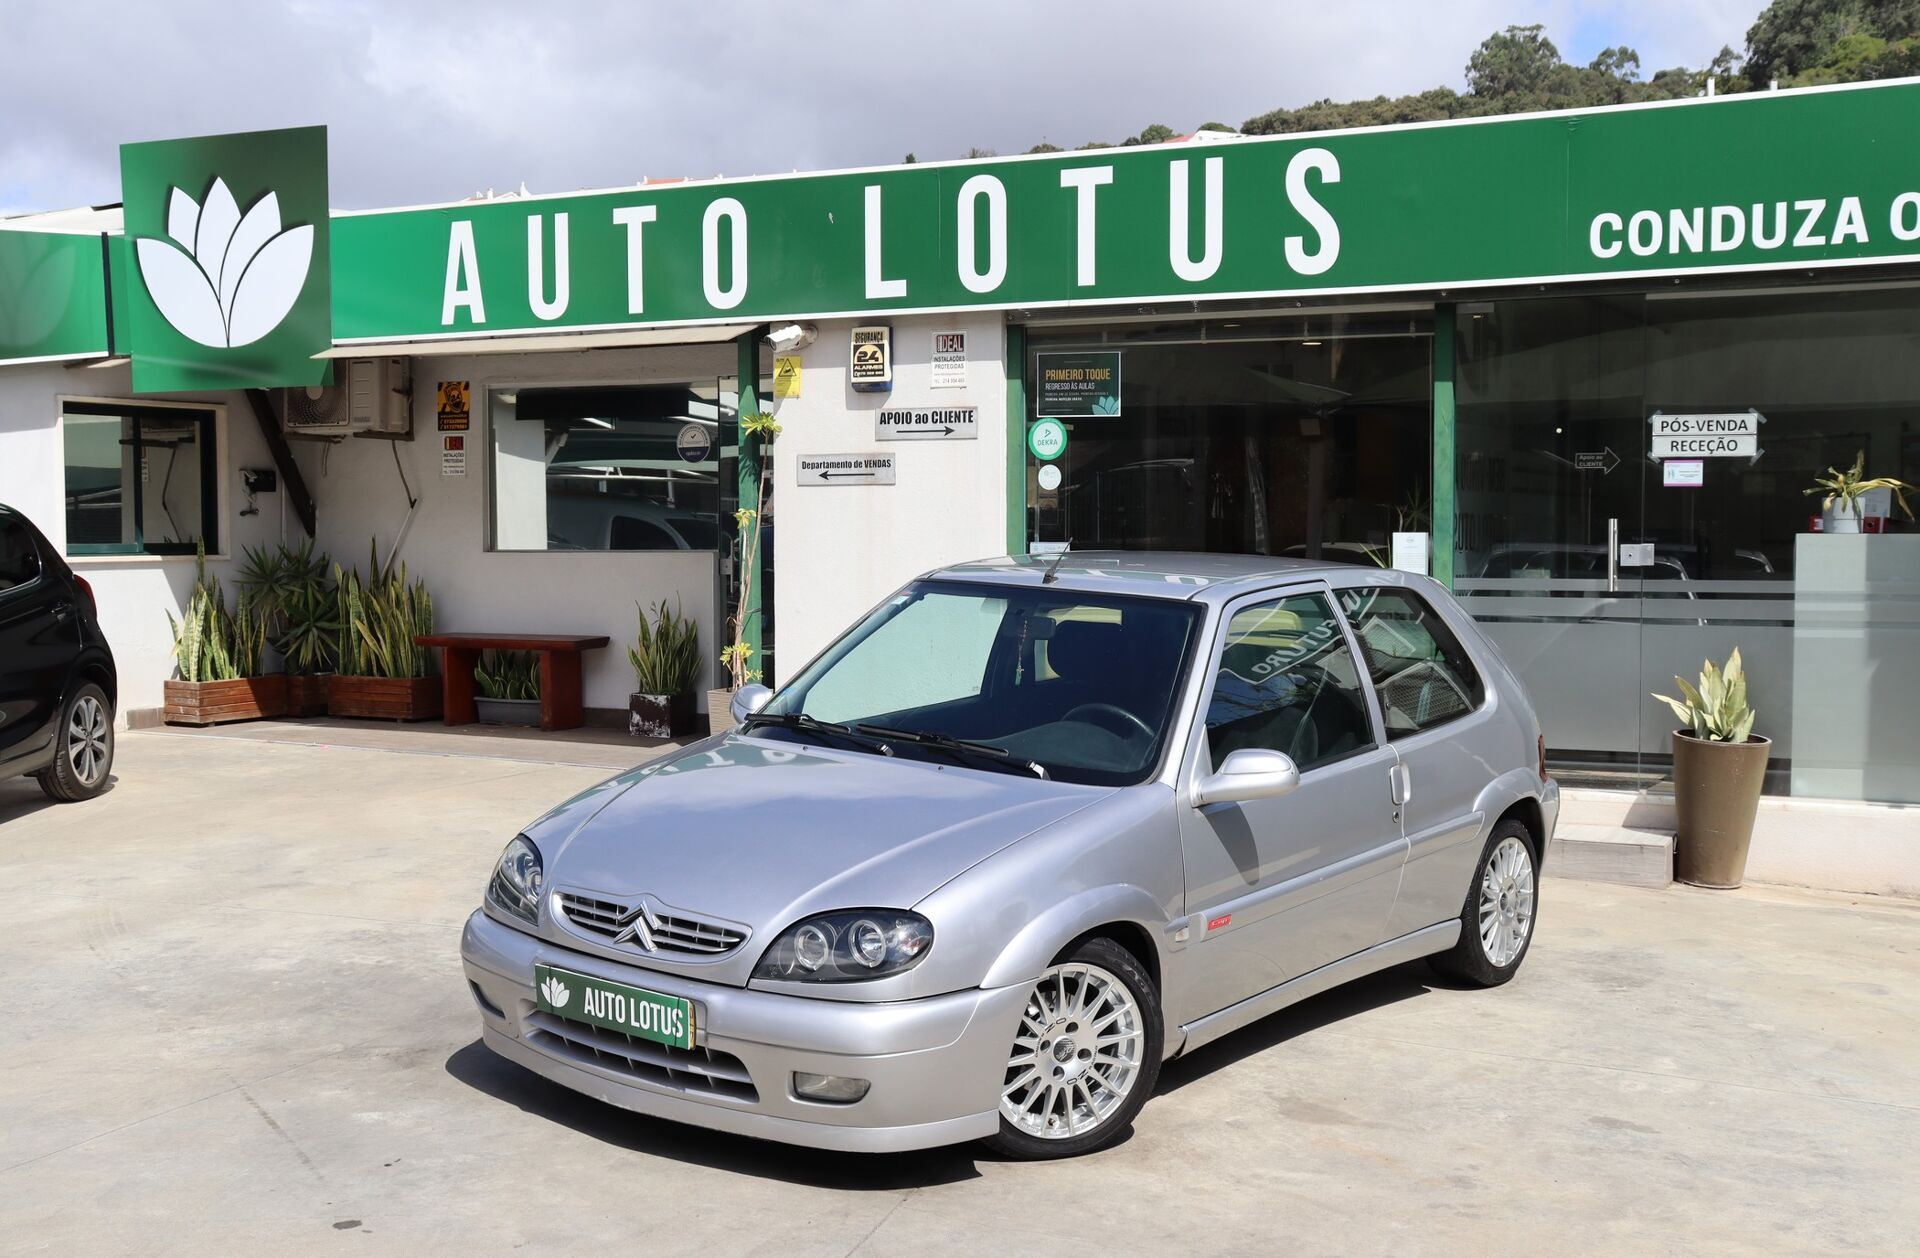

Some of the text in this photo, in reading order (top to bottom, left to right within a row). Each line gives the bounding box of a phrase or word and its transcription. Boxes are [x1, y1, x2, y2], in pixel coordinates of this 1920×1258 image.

[1589, 196, 1869, 258] CONDUZA
[441, 148, 1341, 325] AUTO LOTUS
[855, 332, 884, 344] SEGURANÇA
[938, 335, 963, 352] IDEAL
[856, 350, 880, 363] 24
[934, 355, 965, 363] INSTALAÇÕES
[1045, 368, 1111, 381] PRIMEIRO TOQUE
[1045, 382, 1070, 390] REGRESSO
[879, 410, 973, 425] APOIO ao CLIENTE
[1660, 417, 1748, 432] PÓS-VENDA
[1670, 436, 1738, 454] RECEÇÃO
[802, 459, 891, 470] Departamento de VENDAS
[584, 987, 684, 1038] AUTO LOTUS
